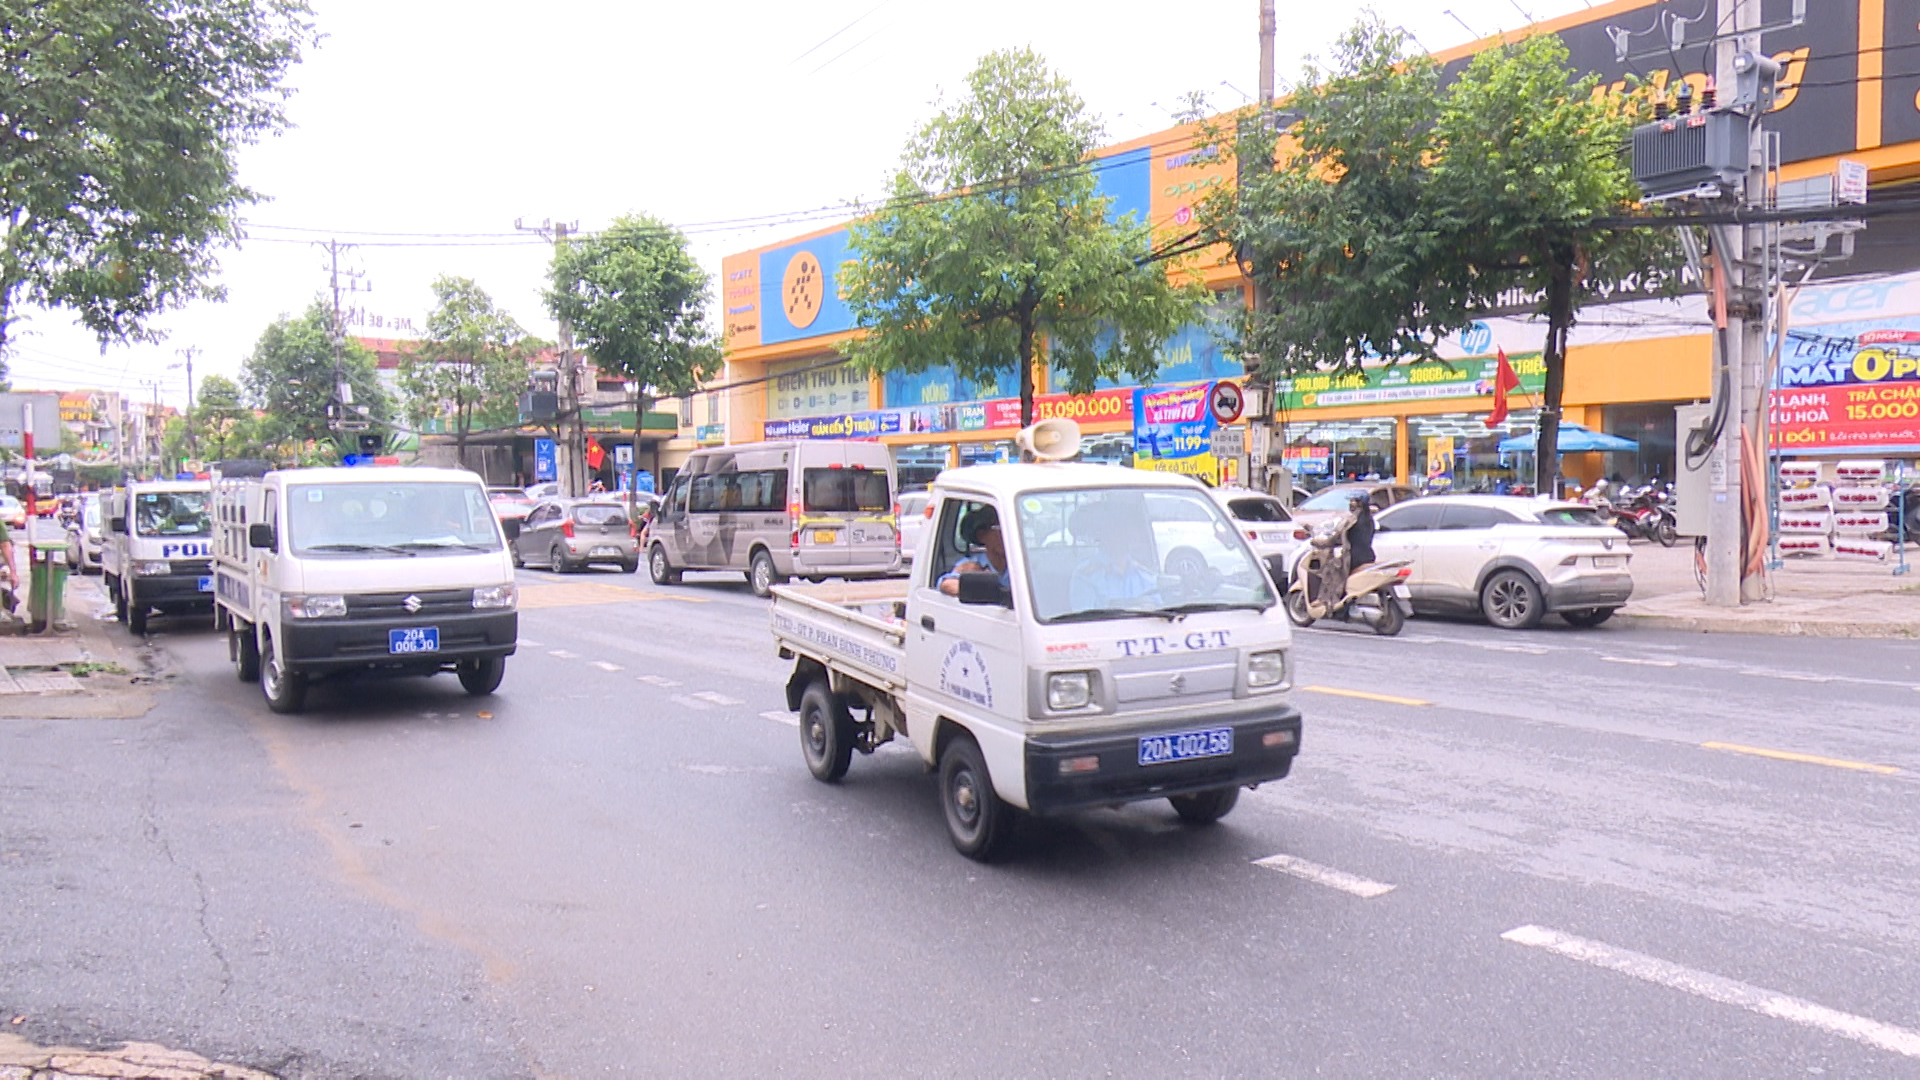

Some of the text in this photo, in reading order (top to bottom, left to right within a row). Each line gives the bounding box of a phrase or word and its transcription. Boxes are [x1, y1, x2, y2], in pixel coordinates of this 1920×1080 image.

[1792, 281, 1907, 316] acer
[1463, 327, 1489, 355] hp
[811, 369, 837, 388] THU
[1039, 395, 1122, 419] 13.090.000
[788, 420, 809, 435] Haier
[845, 415, 853, 436] 9
[1818, 430, 1826, 442] 1
[404, 629, 425, 640] 20A
